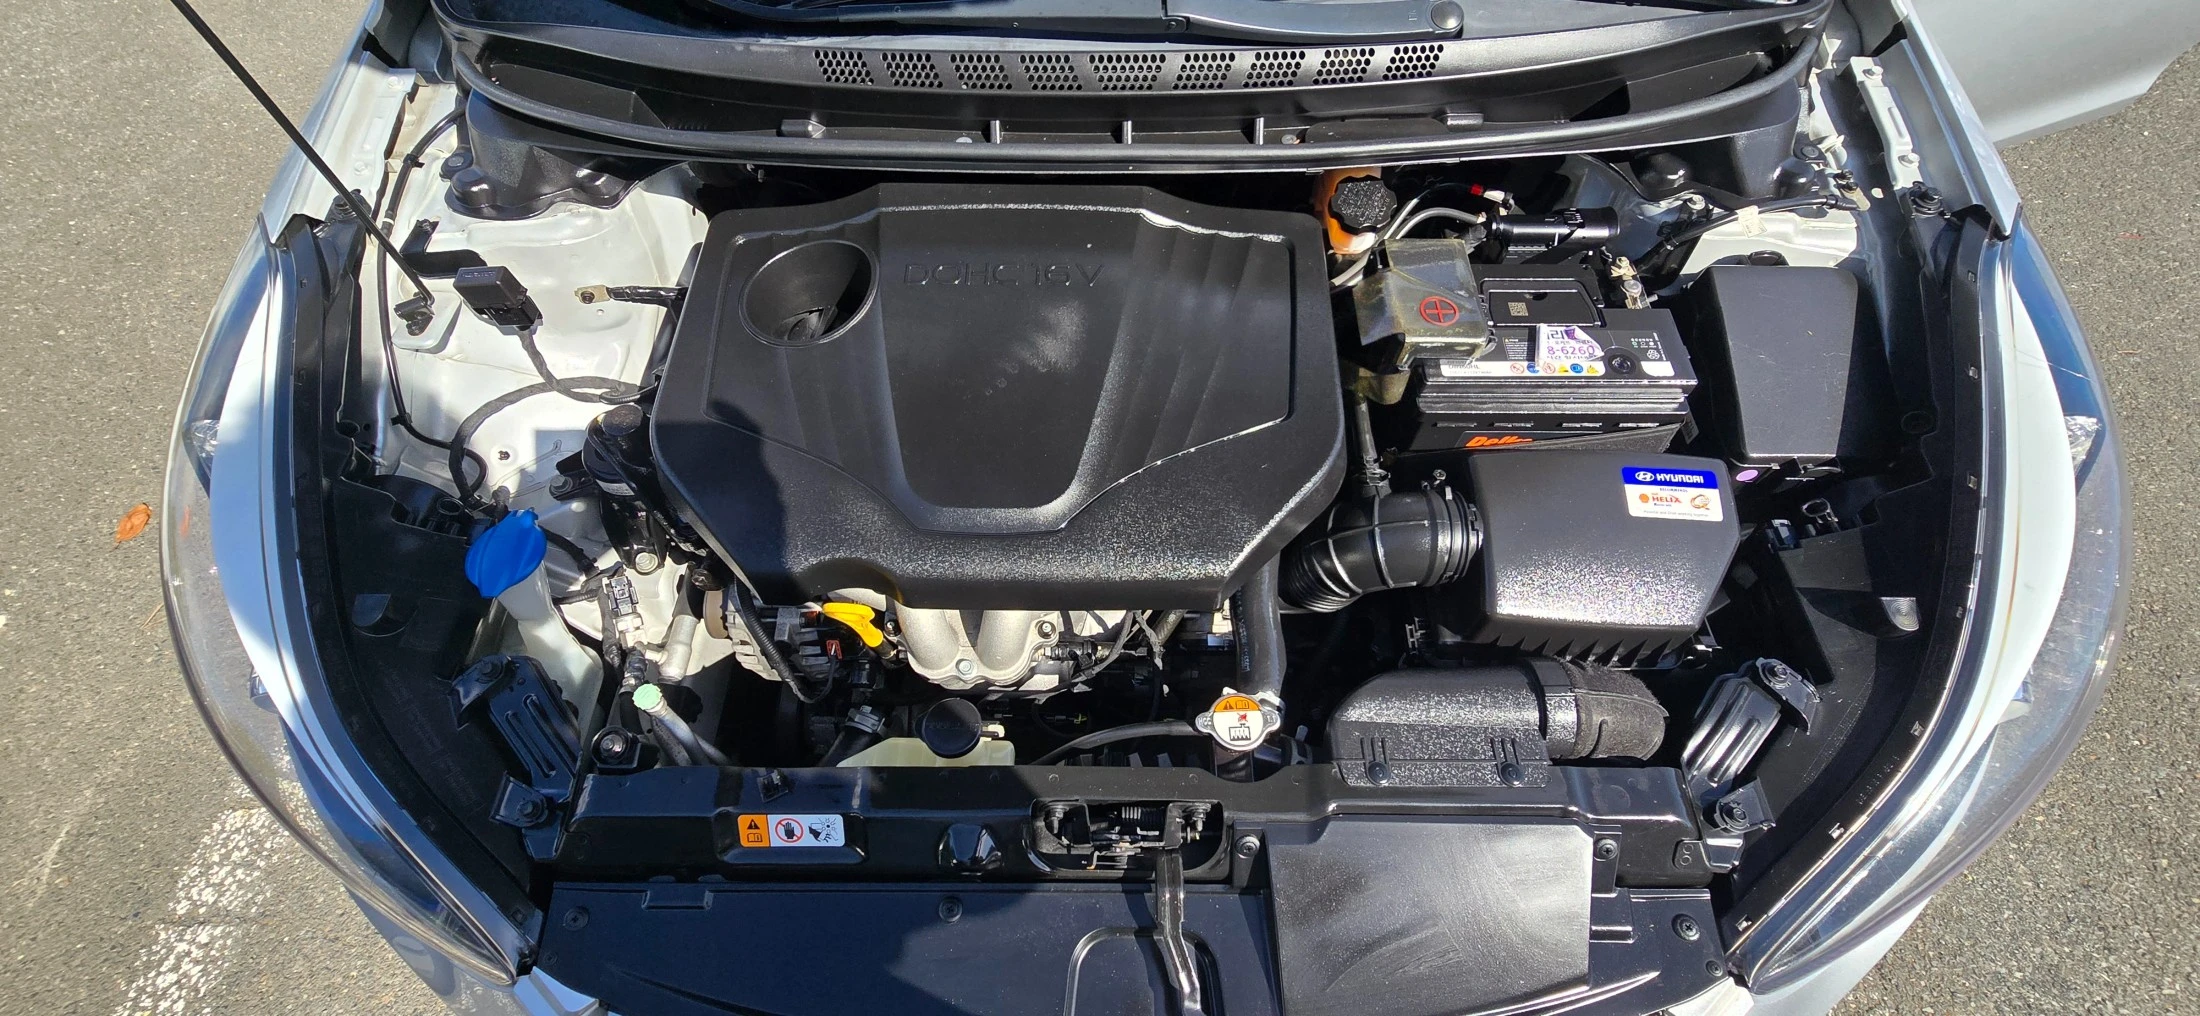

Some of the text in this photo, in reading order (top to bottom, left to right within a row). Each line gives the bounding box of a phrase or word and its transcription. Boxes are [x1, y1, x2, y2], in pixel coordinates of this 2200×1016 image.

[904, 263, 1105, 287] DOHC 16V
[1656, 473, 1705, 484] HYUNDAI
[1652, 494, 1683, 504] HELIX
